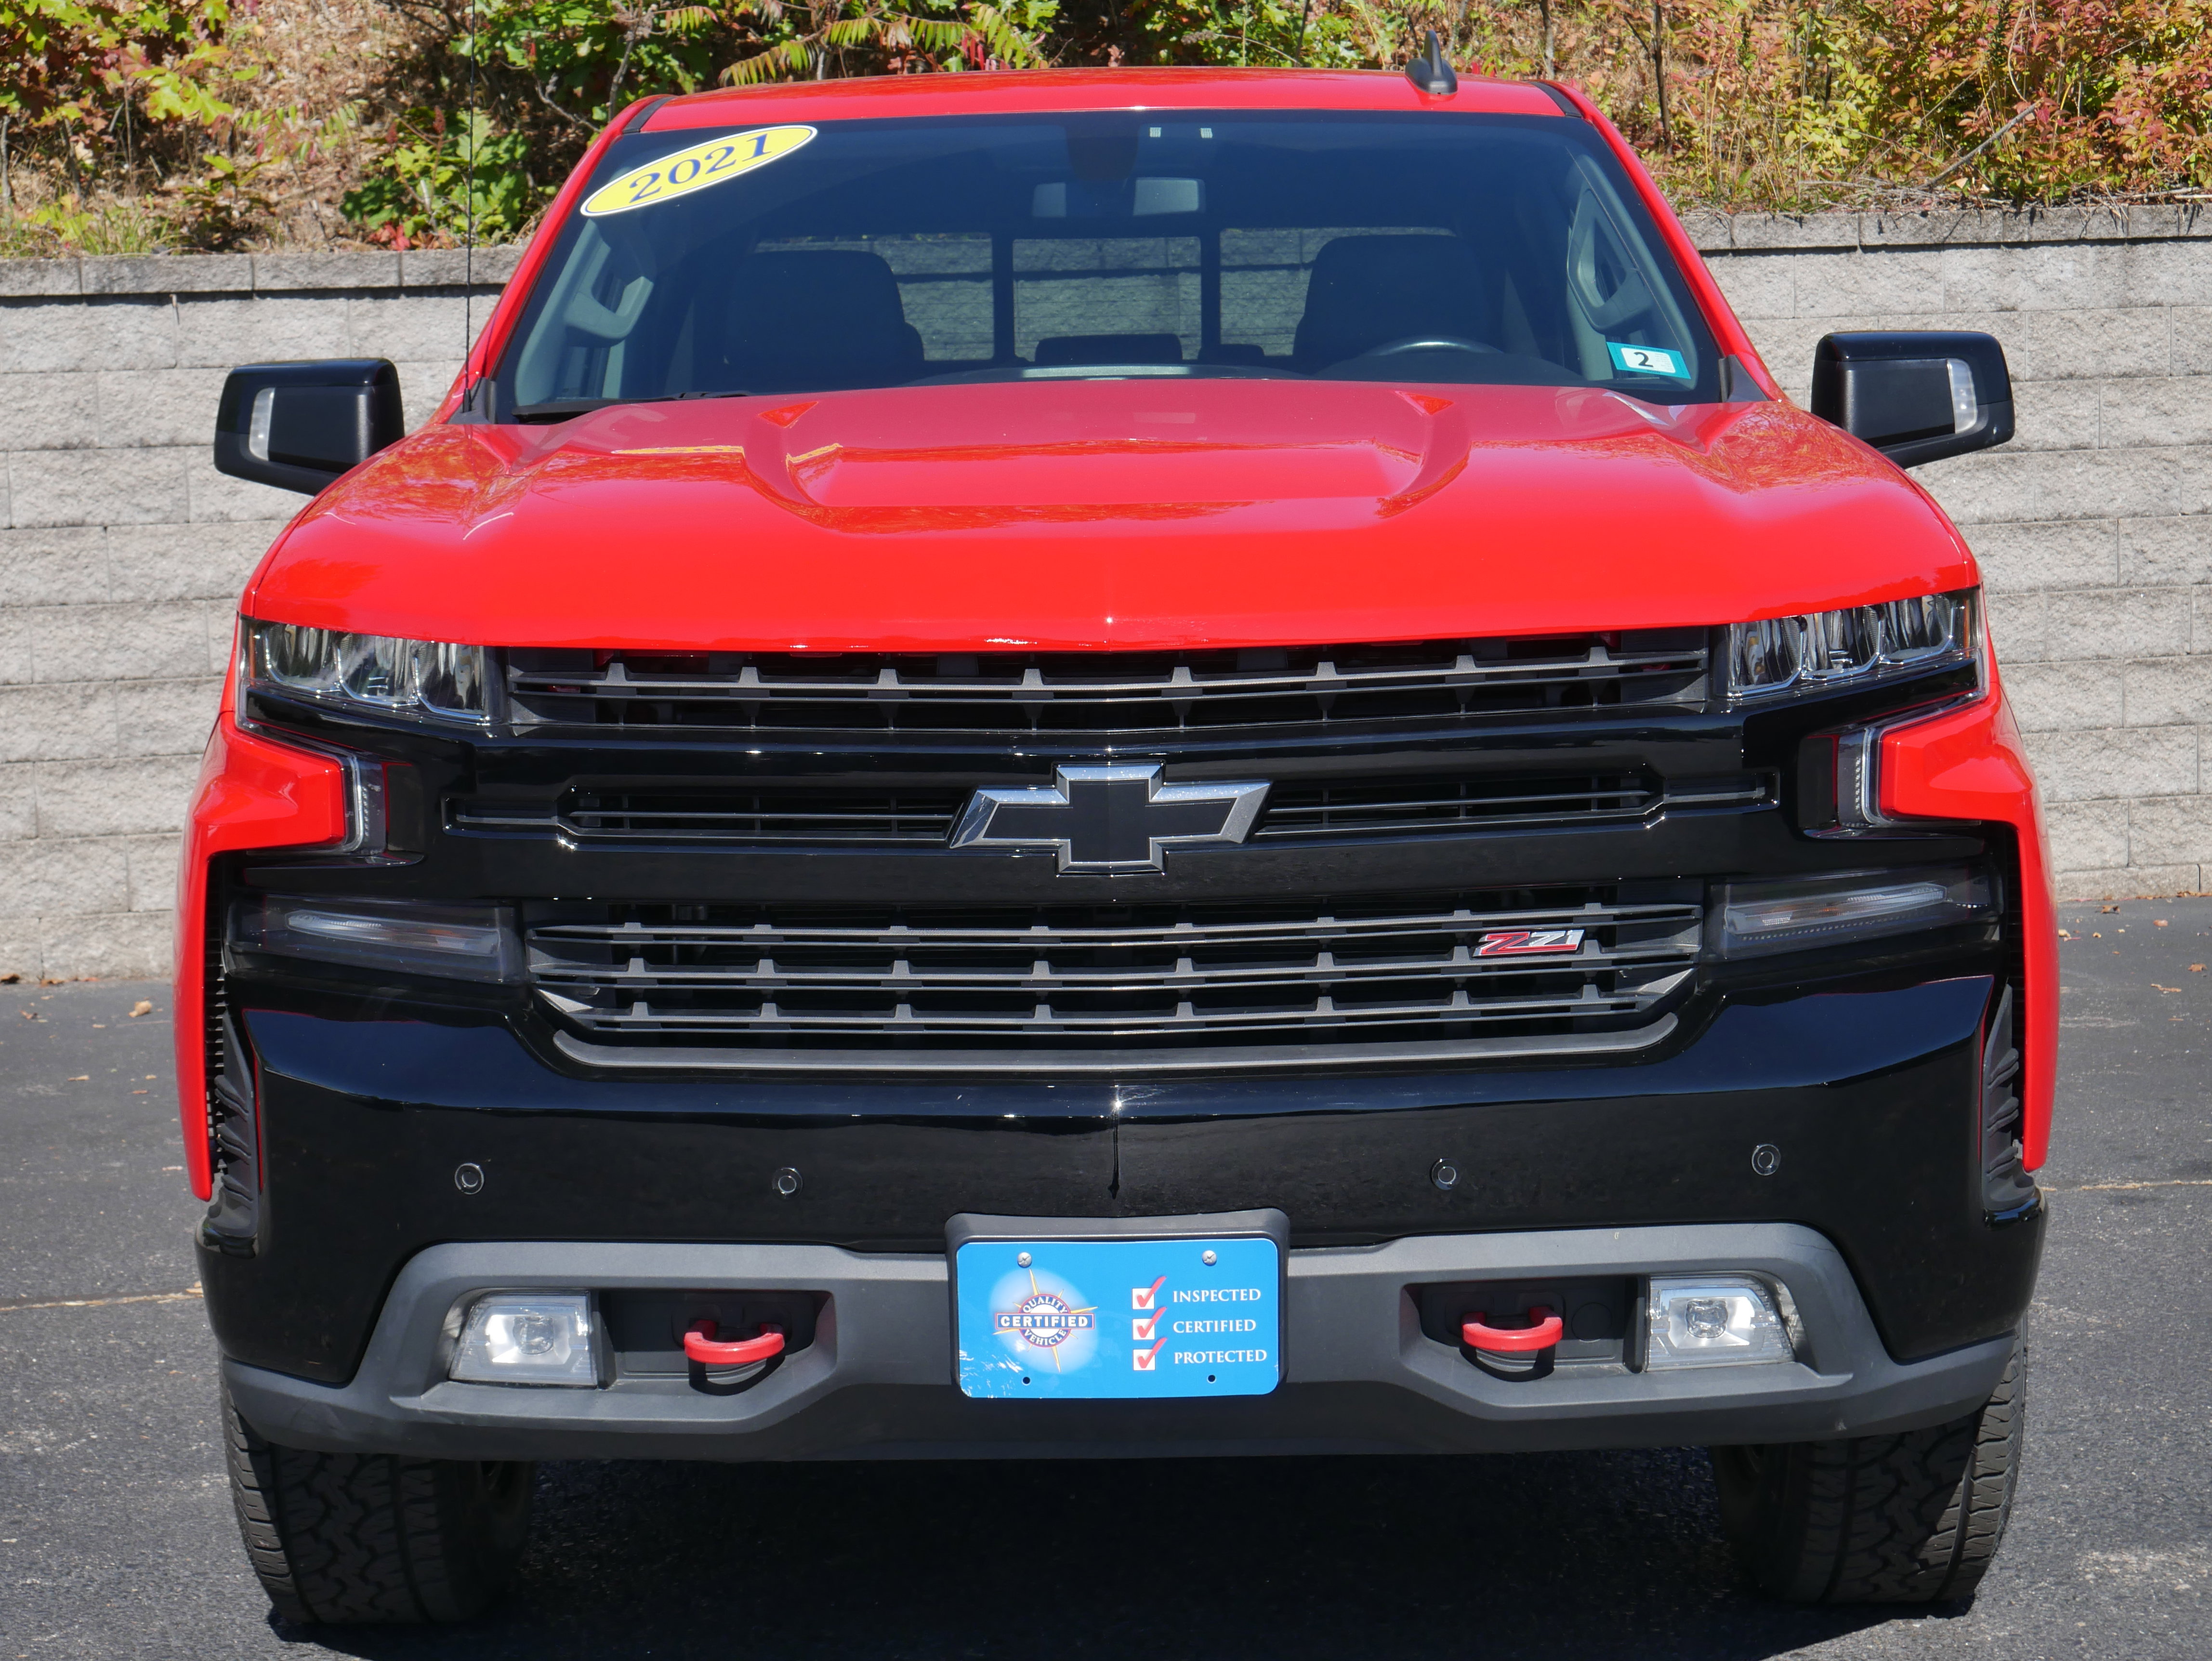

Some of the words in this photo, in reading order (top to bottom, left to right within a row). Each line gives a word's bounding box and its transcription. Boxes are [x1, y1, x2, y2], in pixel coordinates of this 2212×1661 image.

[629, 133, 772, 203] 2021
[1633, 352, 1654, 368] 2
[1474, 930, 1584, 956] Z71
[1172, 1288, 1261, 1303] INSPECTED
[1023, 1297, 1067, 1313] QUALITY
[1000, 1316, 1088, 1327] CERTIFIED
[1172, 1319, 1256, 1333] CERTIFIED
[1024, 1329, 1067, 1346] VEHICLE
[1173, 1349, 1267, 1364] PROTECTED
